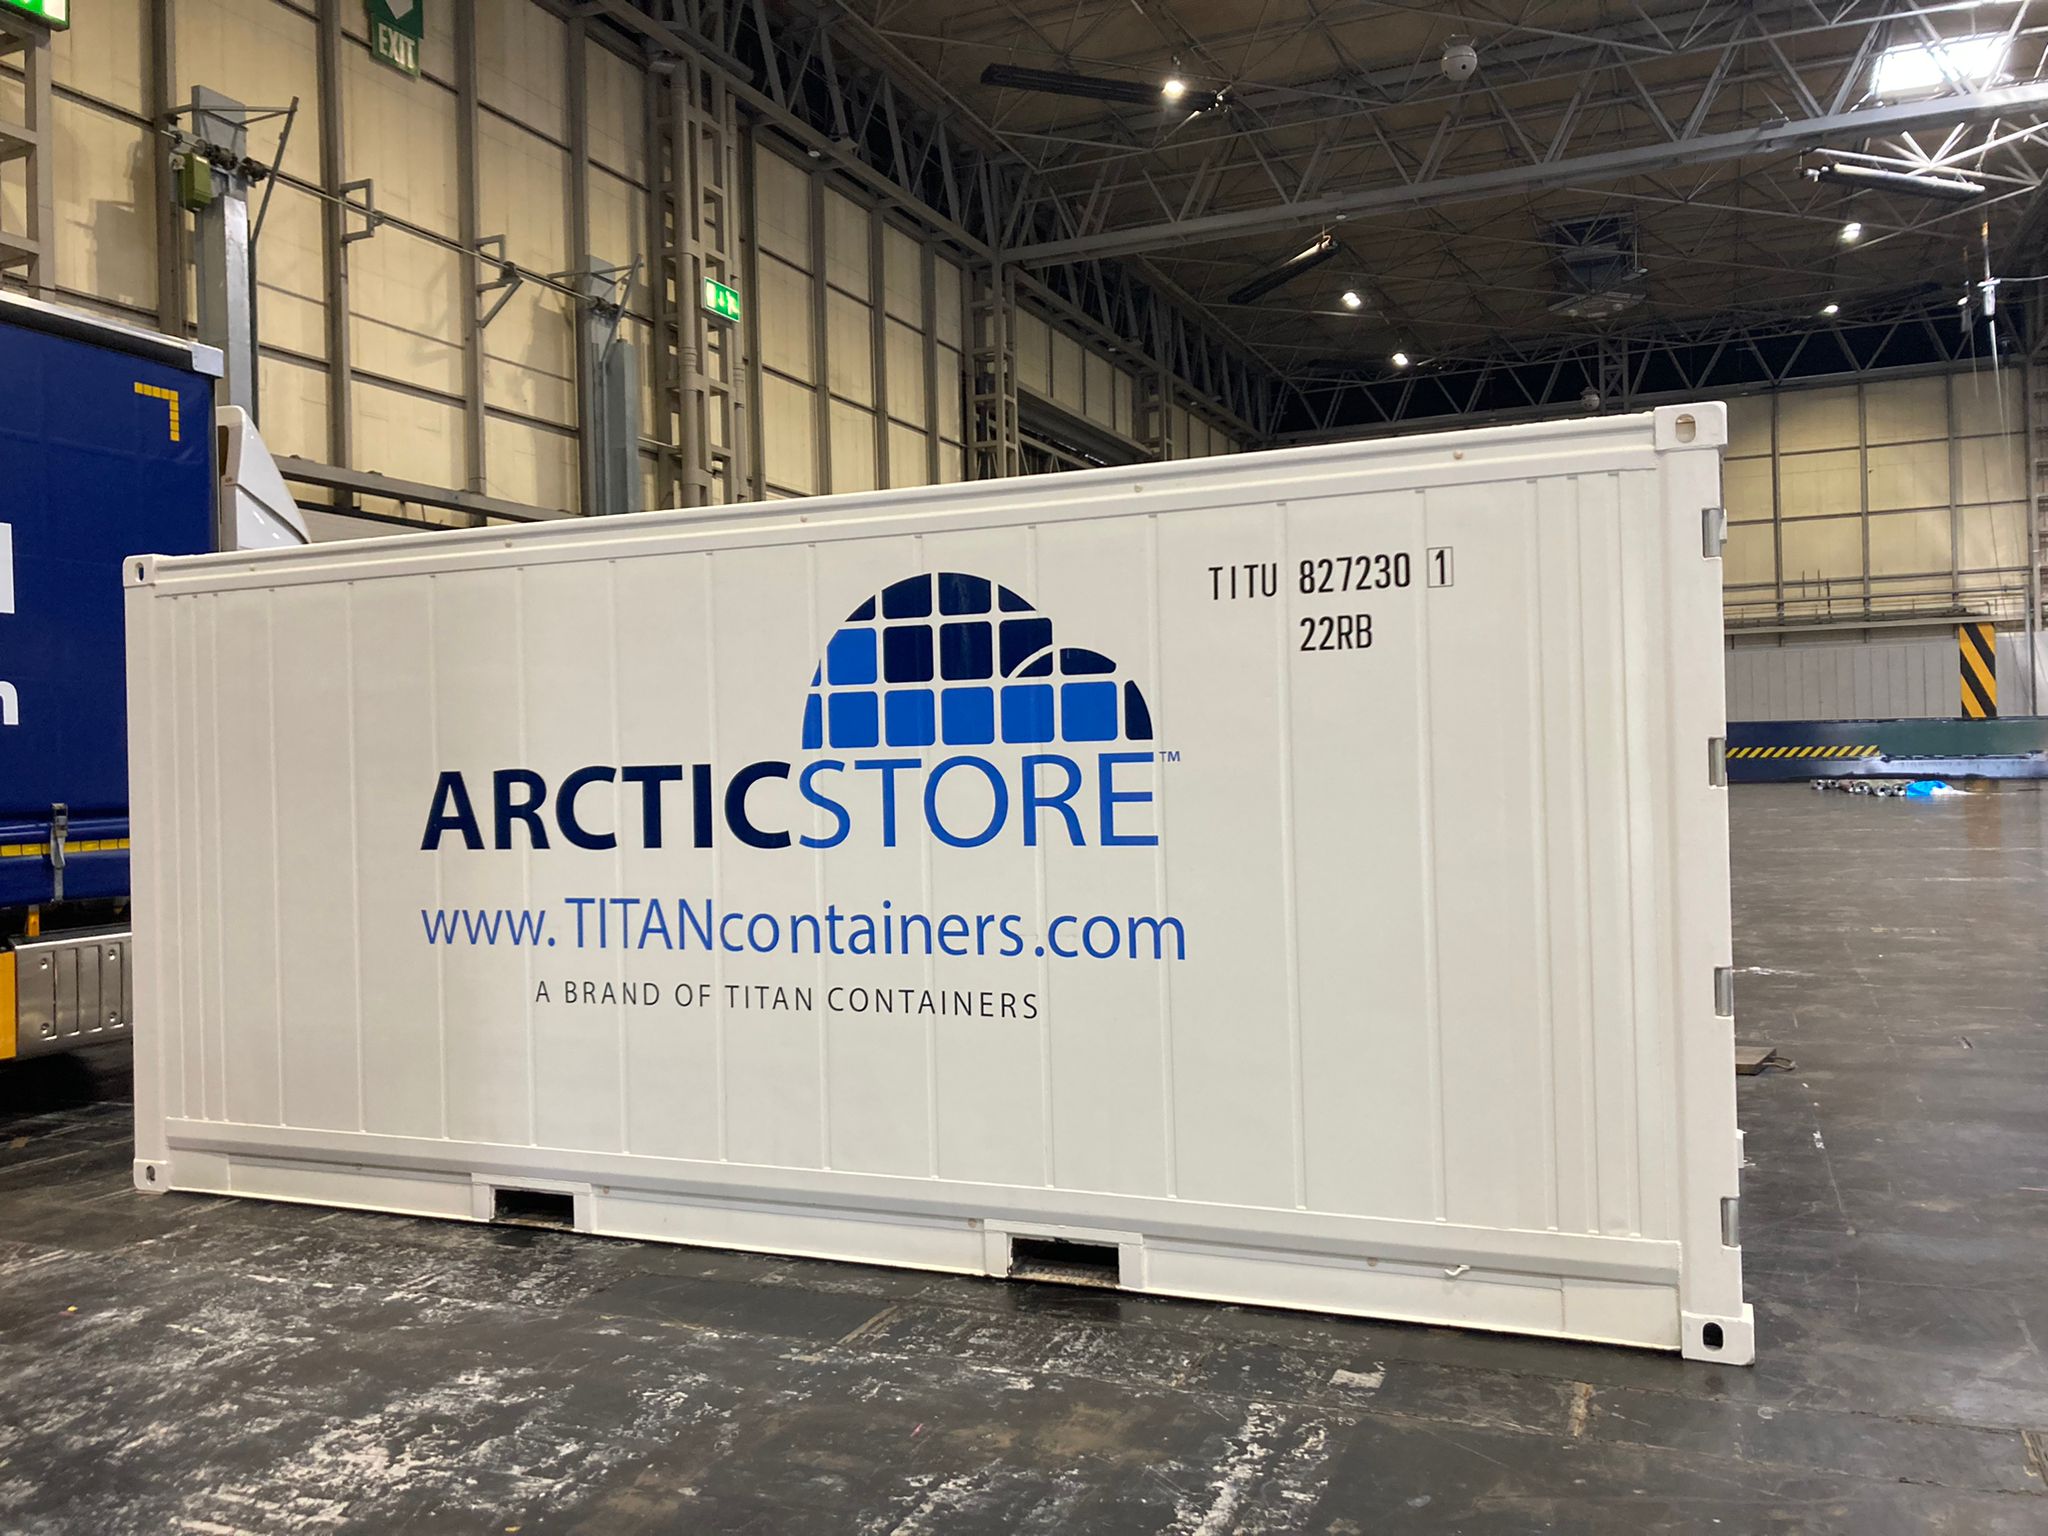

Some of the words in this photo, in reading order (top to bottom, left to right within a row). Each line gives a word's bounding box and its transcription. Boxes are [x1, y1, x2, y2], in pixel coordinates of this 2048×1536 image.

[378, 22, 416, 69] EXIT
[1208, 562, 1278, 600] TITU
[1299, 552, 1411, 594] 827230
[1434, 549, 1447, 585] 1
[1300, 613, 1373, 651] 22RB
[421, 897, 1187, 960] www.TITANcontainers.com
[535, 981, 551, 1004] A
[564, 981, 661, 1006] BRAND
[675, 983, 712, 1008] OF
[724, 985, 814, 1012] TITAN
[828, 987, 1039, 1019] CONTAINERS
